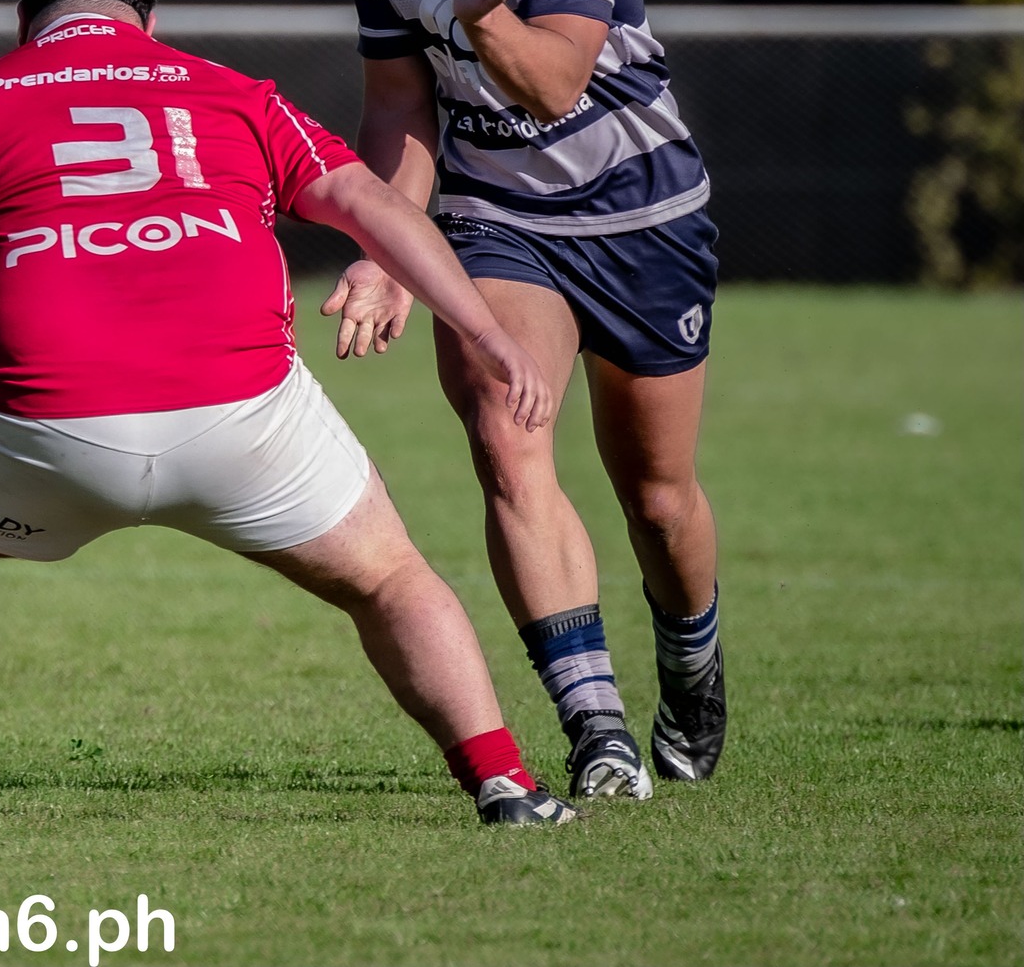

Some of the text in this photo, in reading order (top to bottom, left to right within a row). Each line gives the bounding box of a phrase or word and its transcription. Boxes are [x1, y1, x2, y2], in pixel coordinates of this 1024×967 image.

[36, 24, 116, 48] PROCER
[52, 106, 211, 198] 31
[5, 209, 241, 269] PICON
